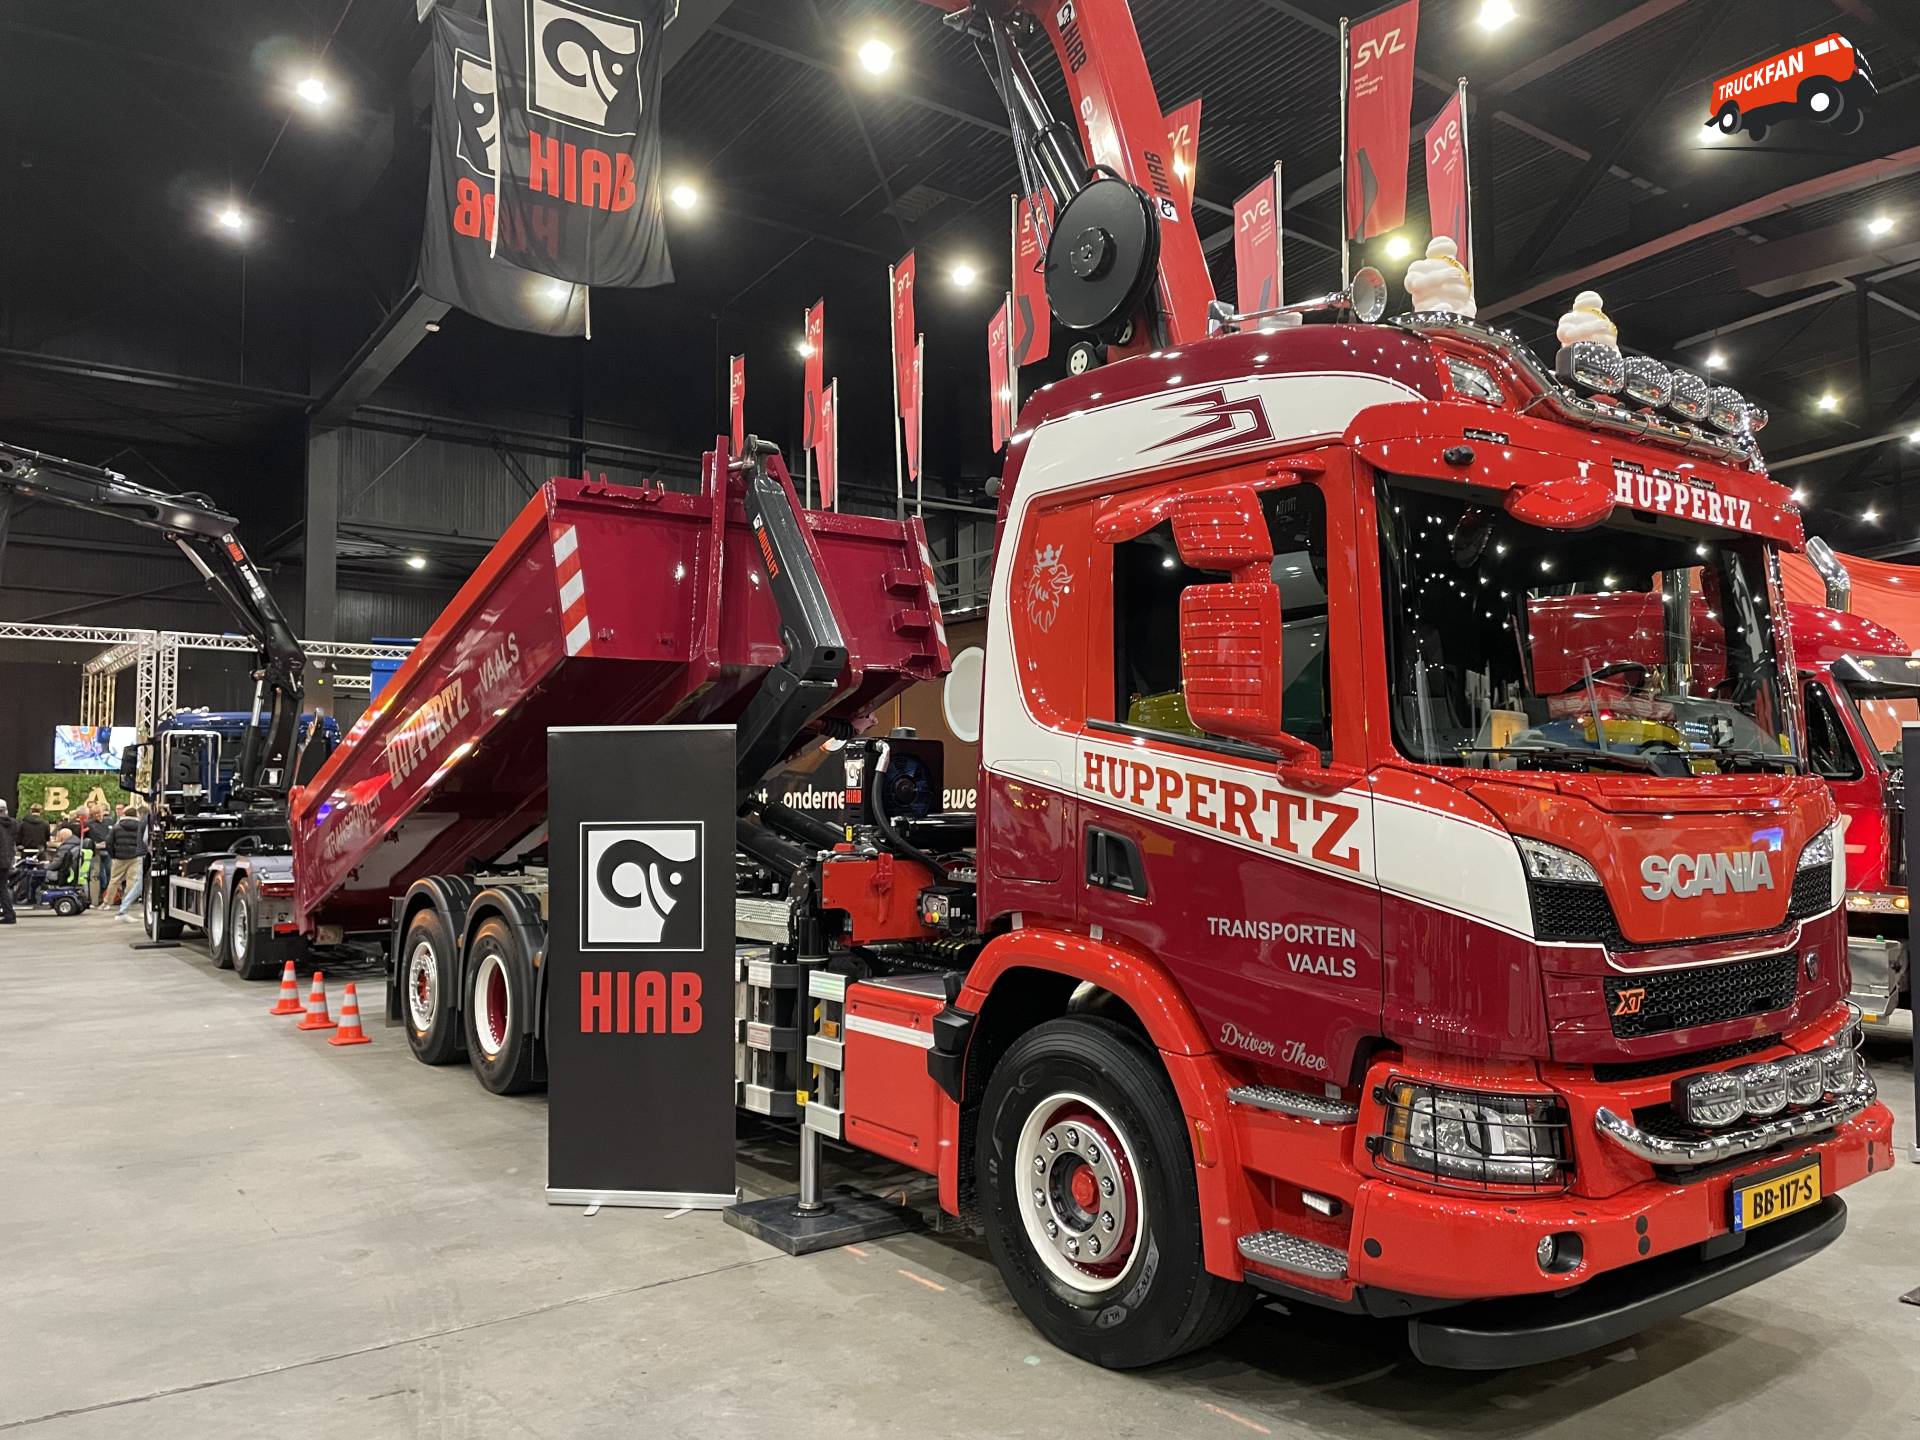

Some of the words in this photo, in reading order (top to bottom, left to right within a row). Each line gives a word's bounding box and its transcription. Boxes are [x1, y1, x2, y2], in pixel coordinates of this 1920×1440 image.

[1062, 23, 1087, 74] HIAB
[1353, 28, 1406, 70] SVZ
[529, 129, 636, 213] HIAB
[1143, 151, 1171, 196] HIAB
[1613, 469, 1753, 530] HUPPERTZ
[757, 526, 780, 580] MULTILIFT
[386, 678, 470, 790] HUPPERTZ
[479, 631, 520, 694] VAALS
[1083, 752, 1361, 872] HUPPERTZ
[1639, 850, 1775, 901] SCANIA
[1206, 916, 1356, 949] TRANSPORTEN
[1286, 953, 1357, 978] VAALS
[580, 971, 703, 1034] HIAB
[1613, 988, 1645, 1015] XT
[1219, 1022, 1276, 1058] Driver
[1284, 1038, 1328, 1072] Theo
[1753, 1174, 1813, 1220] BB-117-S
